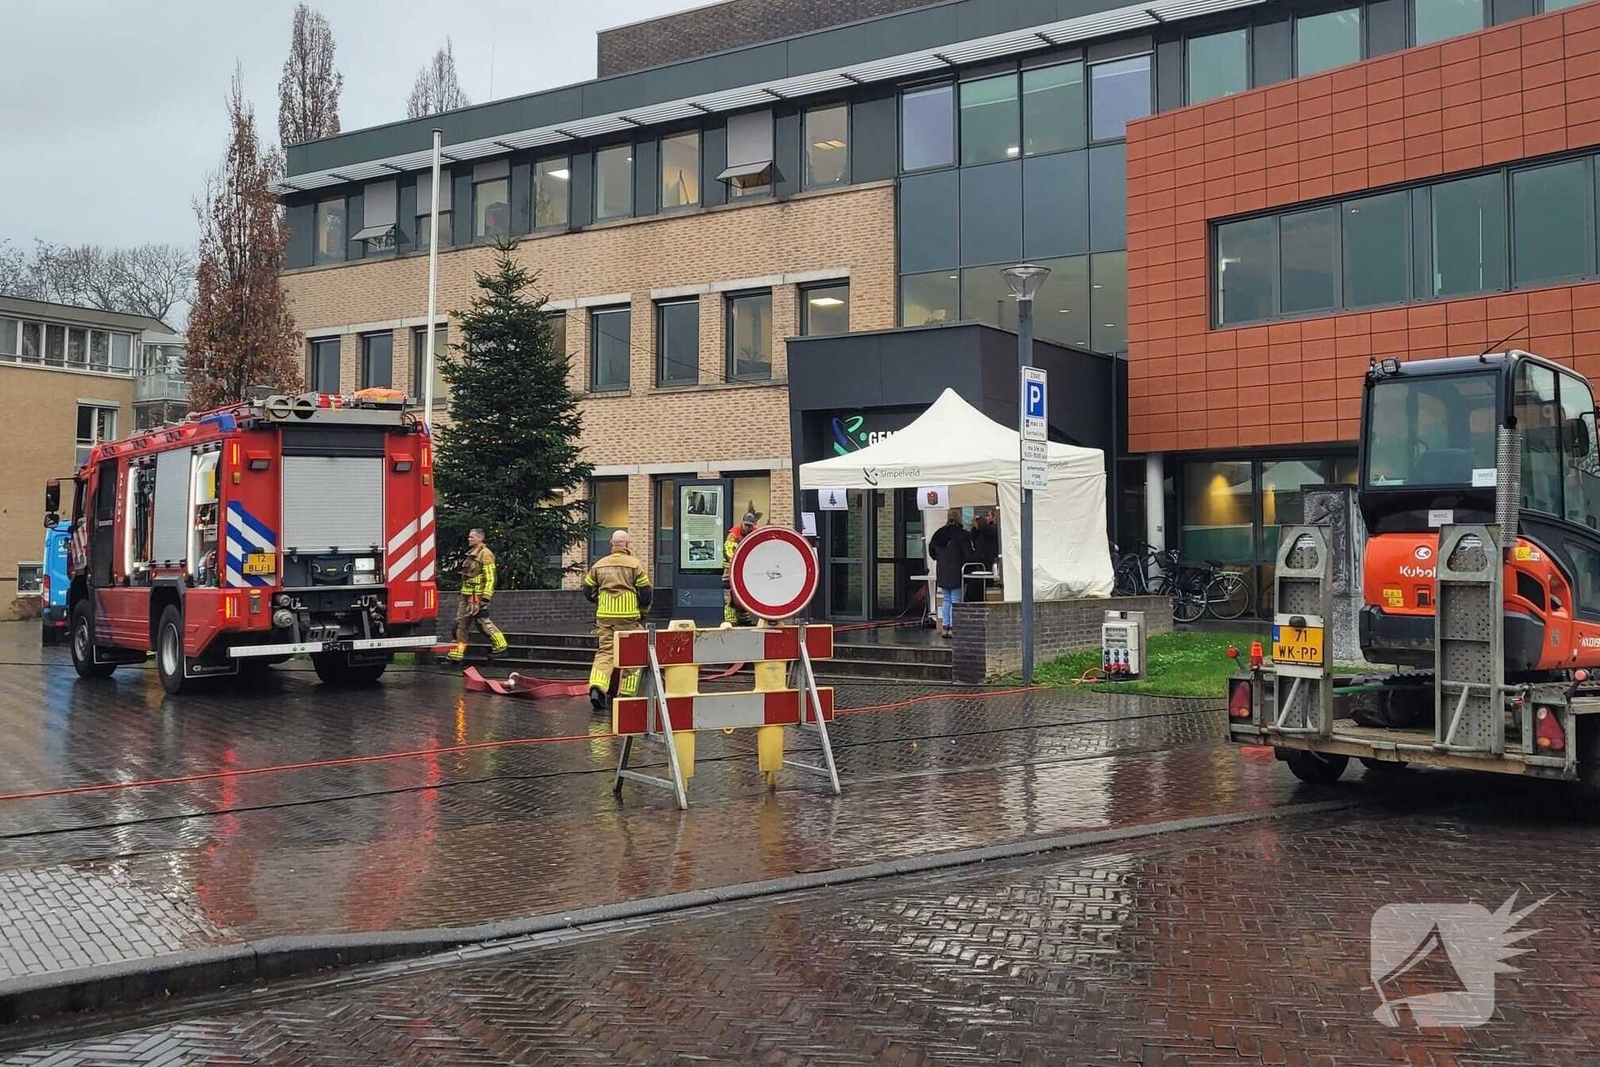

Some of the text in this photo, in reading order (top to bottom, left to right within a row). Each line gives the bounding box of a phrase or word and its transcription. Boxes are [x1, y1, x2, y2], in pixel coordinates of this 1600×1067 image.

[1030, 385, 1041, 413] P
[880, 469, 920, 480] Simpelveld
[1294, 629, 1308, 642] 71
[1278, 645, 1318, 660] WK-PP
